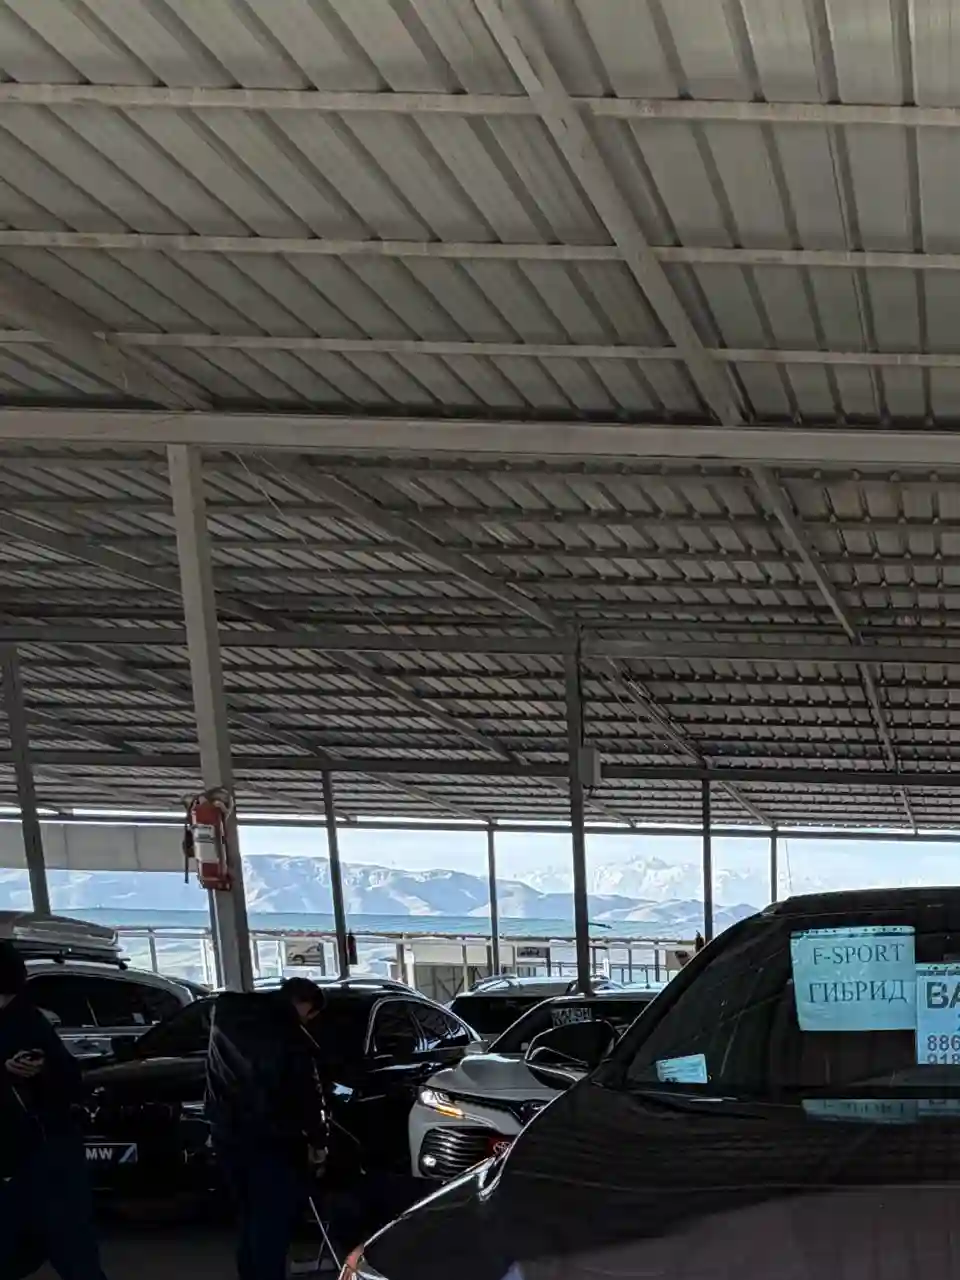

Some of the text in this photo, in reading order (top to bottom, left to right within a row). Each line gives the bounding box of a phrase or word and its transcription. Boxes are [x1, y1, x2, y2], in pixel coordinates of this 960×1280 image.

[812, 943, 905, 965] F-SPORT
[808, 979, 908, 1004] ГИБРИД
[85, 1147, 113, 1160] MW
